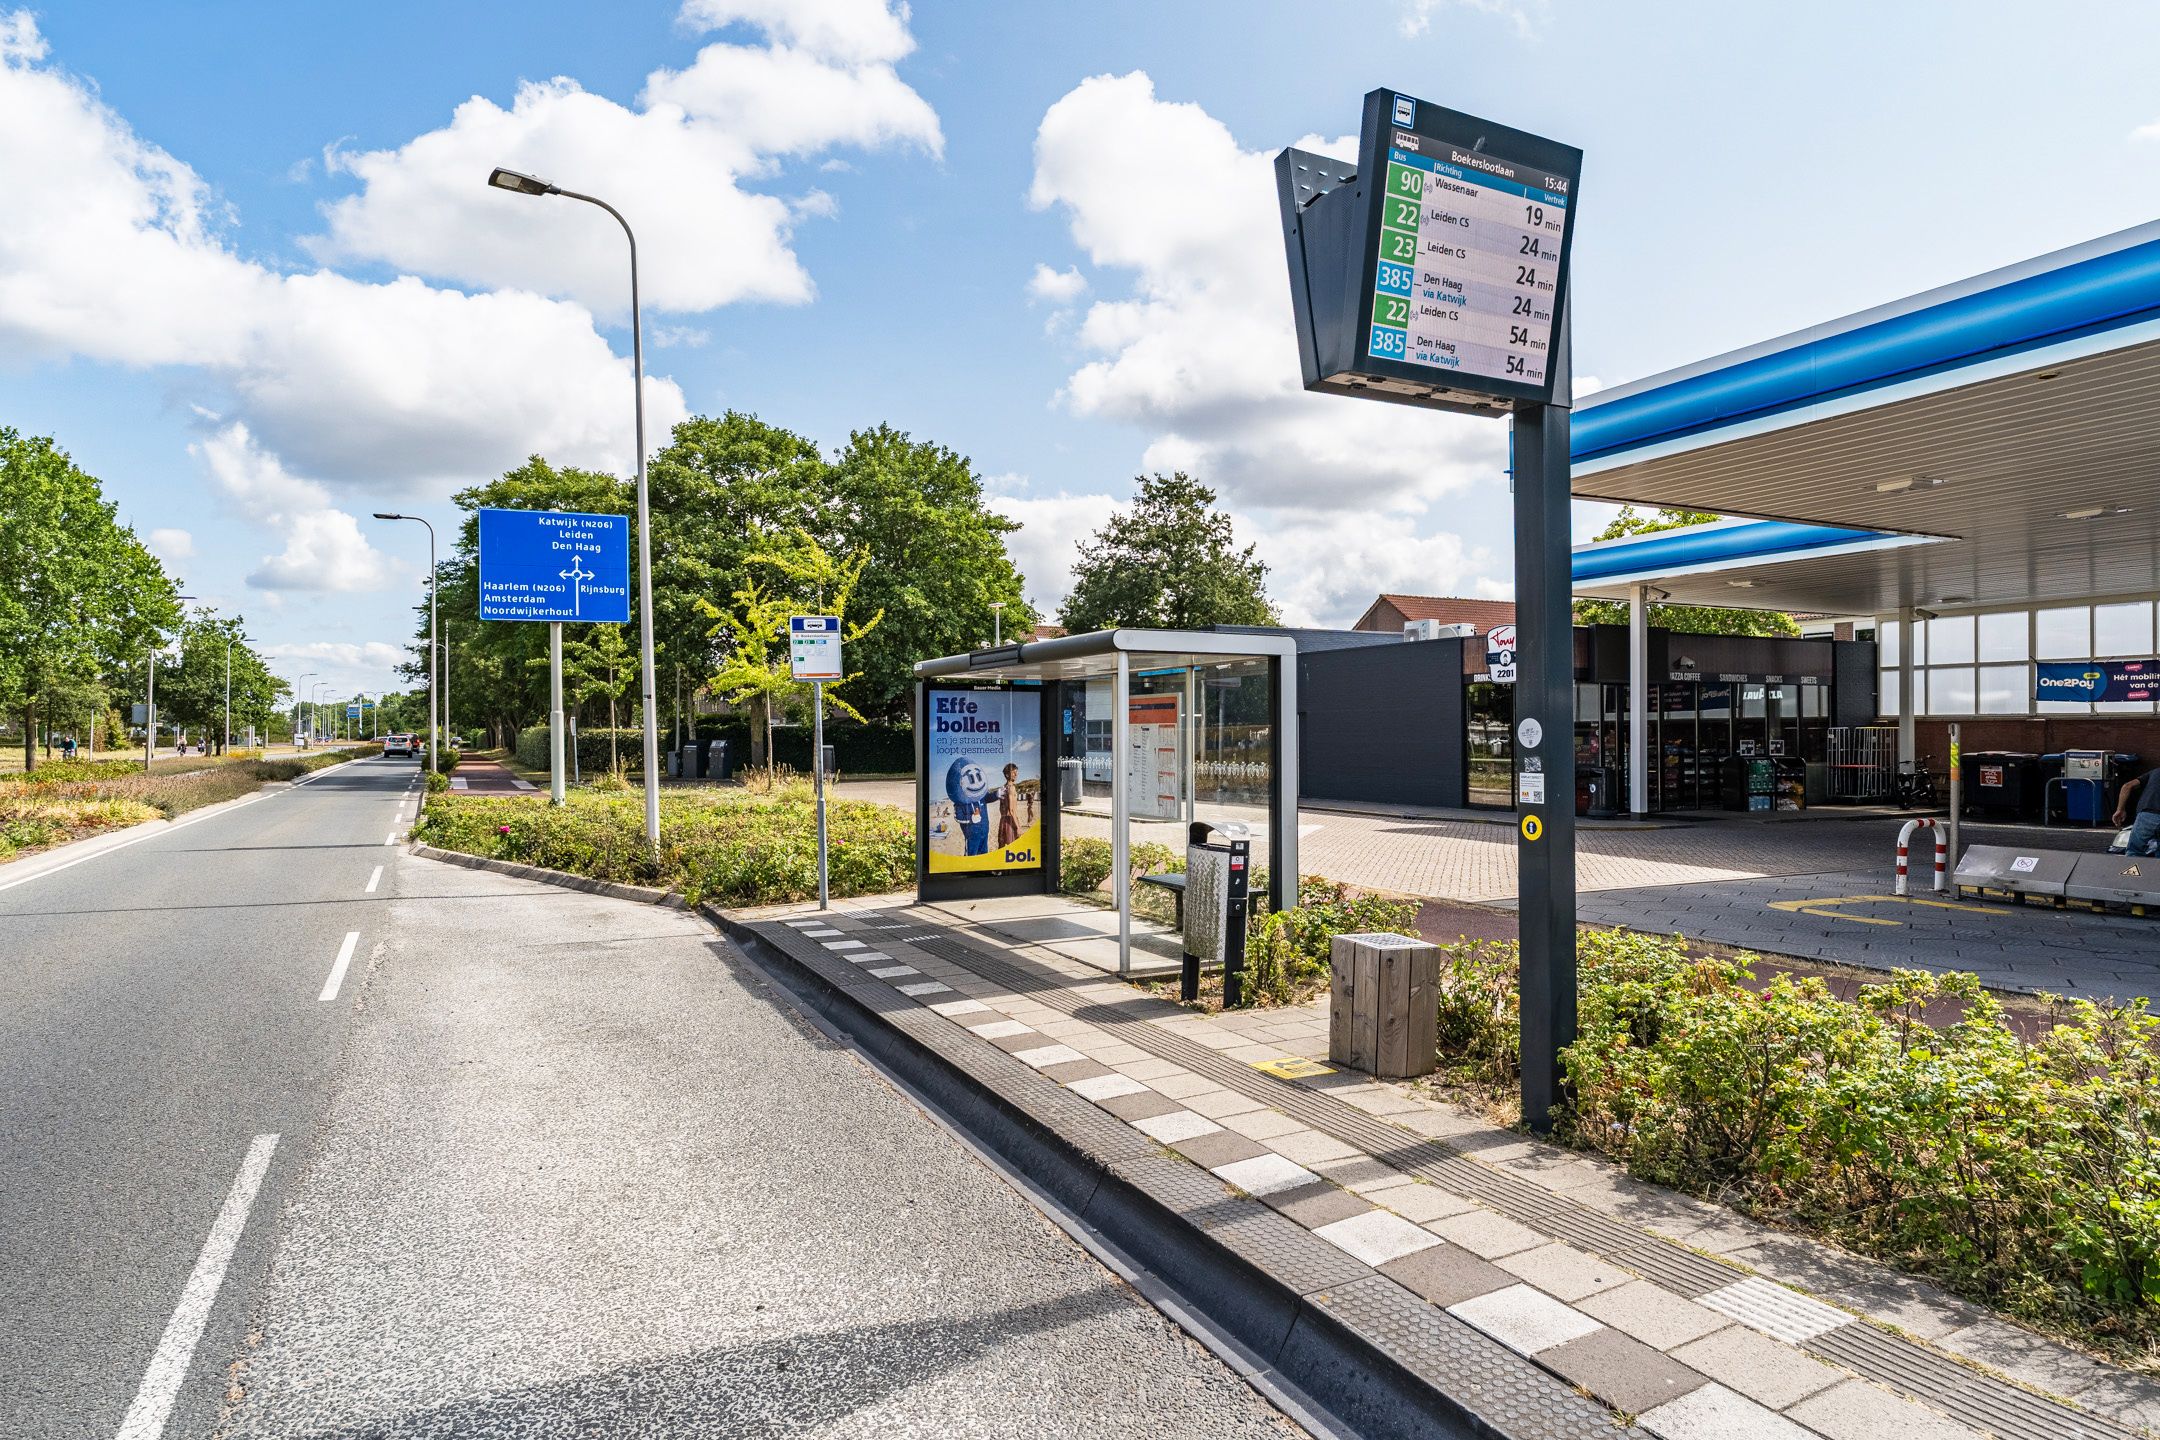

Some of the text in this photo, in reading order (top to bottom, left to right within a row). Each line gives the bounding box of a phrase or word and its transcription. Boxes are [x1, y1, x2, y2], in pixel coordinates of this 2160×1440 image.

[1451, 150, 1568, 193] Boekerslootlaan 15:44
[1394, 151, 1565, 206] Bus Richting Vertrek
[1400, 171, 1561, 232] 90 Wassenaar 19 min
[1396, 203, 1558, 262] 22 Leiden CS 24 min
[1393, 236, 1554, 292] 23 Leiden CS 24 min
[1379, 266, 1550, 322] 385 Den Haag 24 min
[1423, 287, 1467, 307] via Katwijk
[1386, 300, 1547, 351] 22 Leiden CS 54 min
[1373, 330, 1543, 380] 385 Den Haag 54 min
[1416, 350, 1460, 369] via Katwijk
[538, 517, 613, 530] Katwijk (N206)
[559, 530, 594, 540] Leiden
[552, 541, 602, 554] Den Haag
[483, 581, 566, 593] Haarlem (N206)
[580, 584, 625, 596] Rijnsburg
[483, 593, 546, 604] Amsterdam
[483, 606, 574, 618] Noordwijkerhout
[1497, 669, 1514, 679] 2201
[1684, 672, 1701, 682] COFFEE
[1765, 675, 1783, 684] SNACKS
[1800, 676, 1817, 684] SWEETS
[2113, 674, 2129, 682] Hét
[2040, 678, 2094, 689] One2Pay
[2147, 680, 2159, 689] de
[936, 697, 978, 714] Effe
[936, 716, 1001, 733] bollen
[936, 734, 1004, 747] en je stranddag
[936, 743, 1005, 756] loopt gesmeerd
[1005, 849, 1036, 864] bol.
